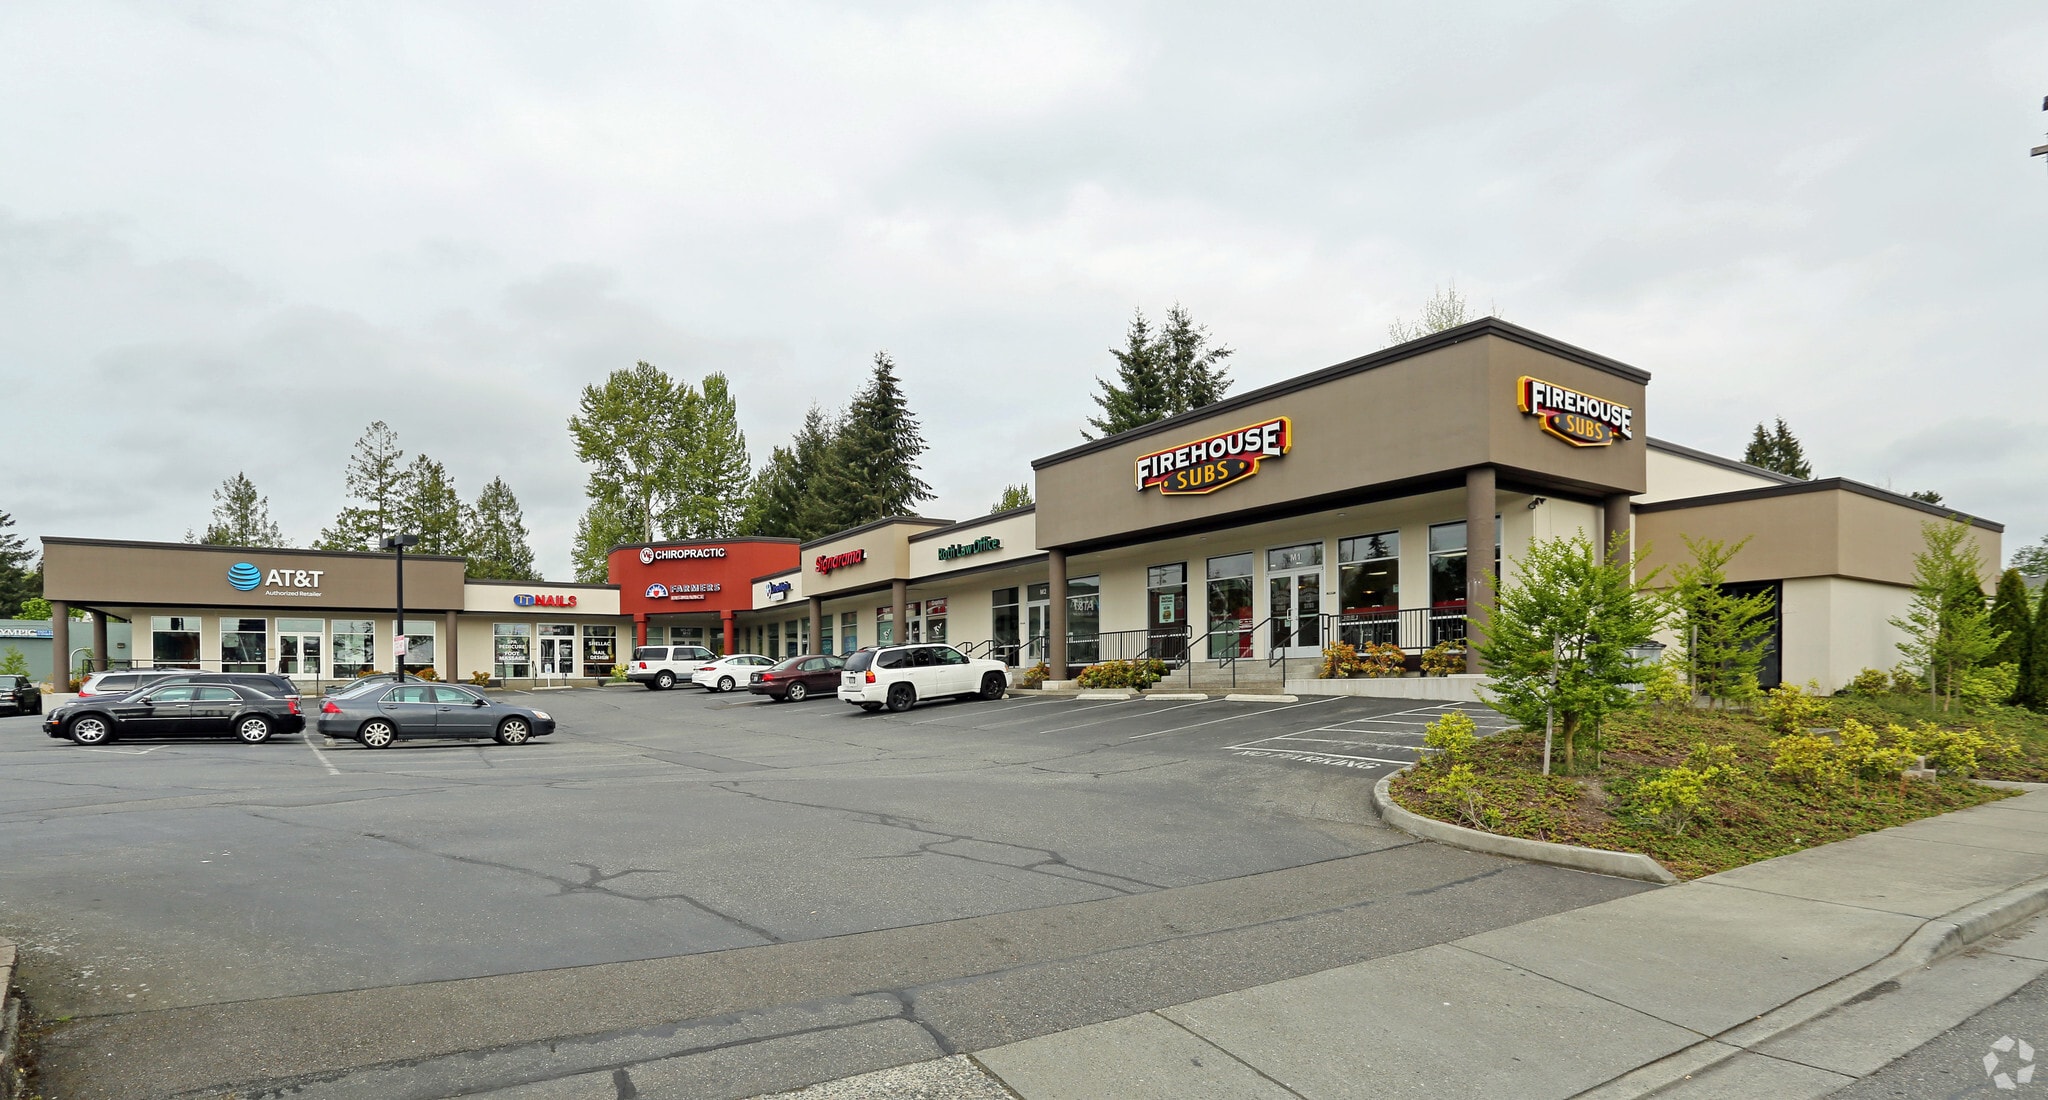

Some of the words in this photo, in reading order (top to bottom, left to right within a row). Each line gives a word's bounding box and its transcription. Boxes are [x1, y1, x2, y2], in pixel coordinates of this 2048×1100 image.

[1532, 381, 1632, 439] FIREHOUSE
[1566, 415, 1603, 440] SUBS
[1137, 421, 1281, 491] FIREHOUSE
[1176, 460, 1229, 489] SUBS
[655, 548, 725, 560] CHIROPRACTIC
[938, 545, 955, 560] Roth
[956, 544, 973, 557] Law
[973, 536, 1000, 554] Office
[815, 549, 862, 574] Signarama
[265, 569, 324, 588] AT&T
[670, 583, 721, 593] FARMERS
[535, 595, 577, 607] NAILS
[1271, 753, 1381, 770] PARKING
